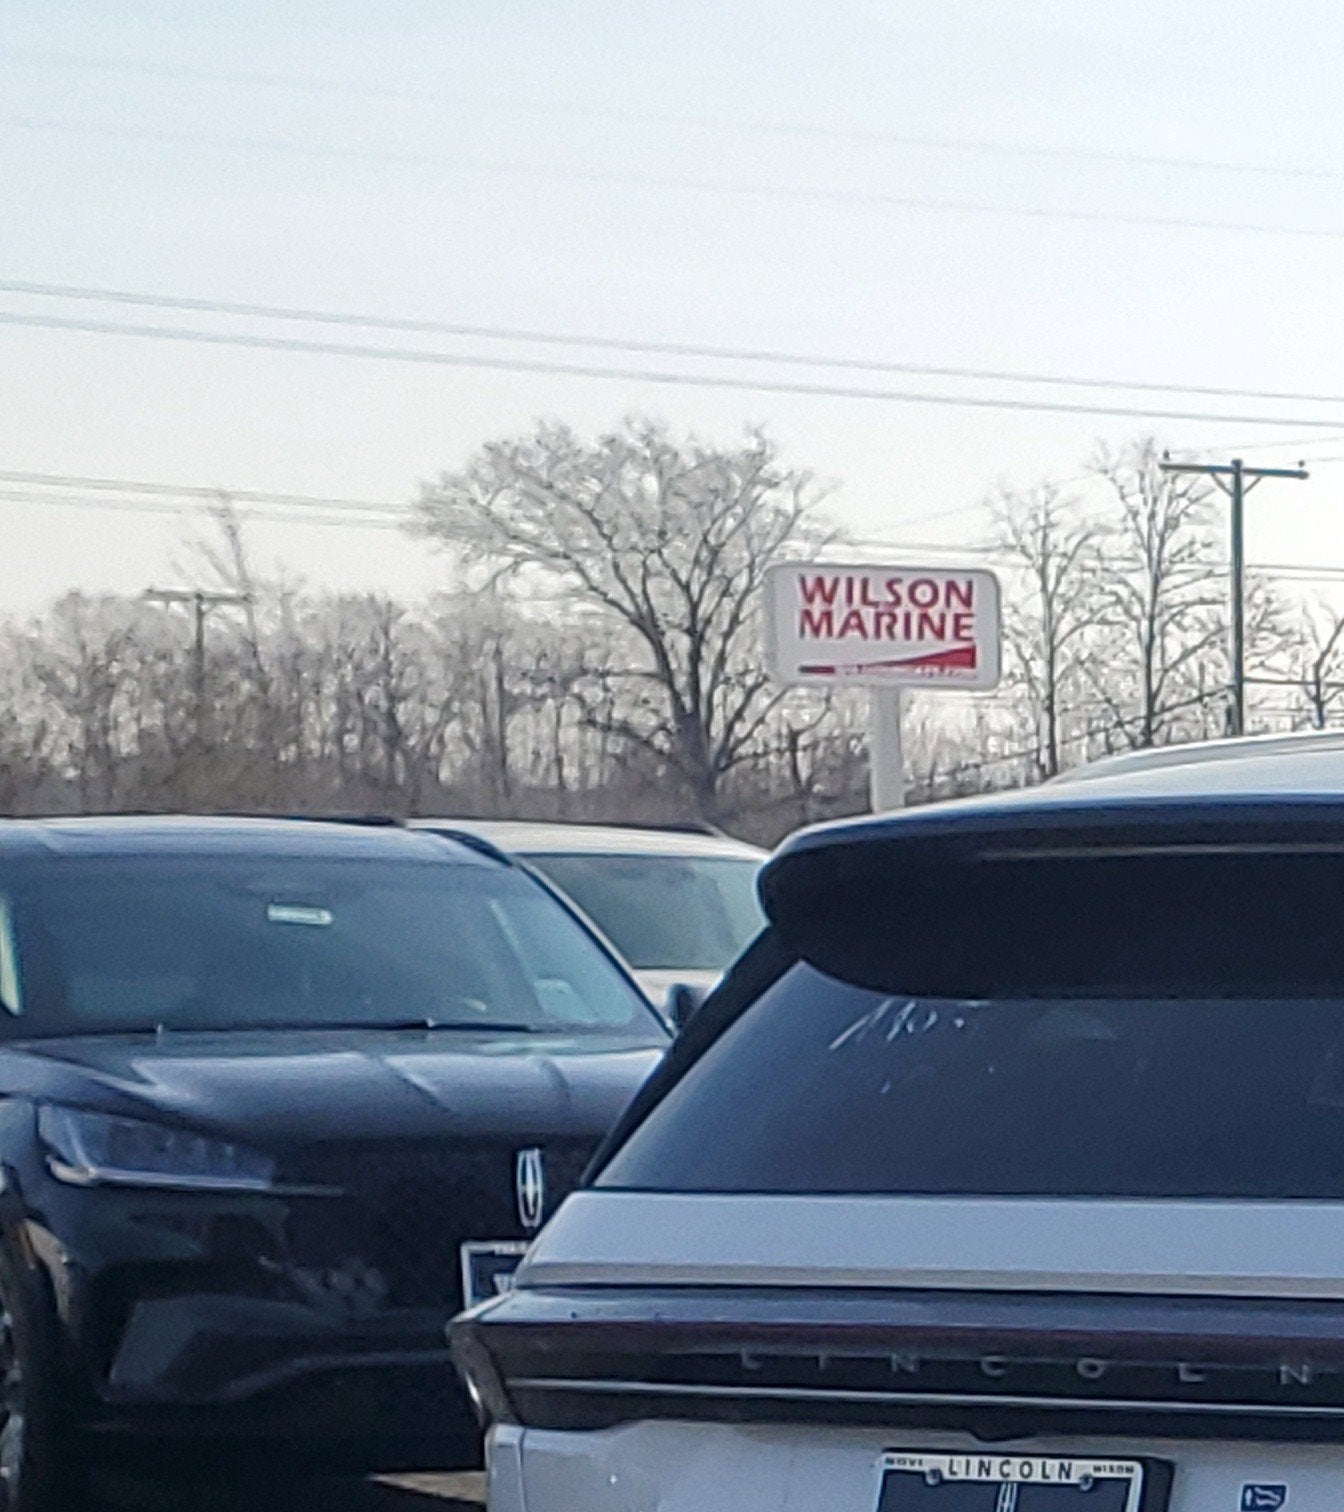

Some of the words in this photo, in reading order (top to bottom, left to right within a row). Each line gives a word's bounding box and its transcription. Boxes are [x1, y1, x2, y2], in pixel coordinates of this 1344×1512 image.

[798, 573, 974, 610] WILSON
[799, 608, 976, 642] MARINE
[740, 1347, 1311, 1386] LINCOLN
[948, 1458, 1073, 1480] LINCOLN
